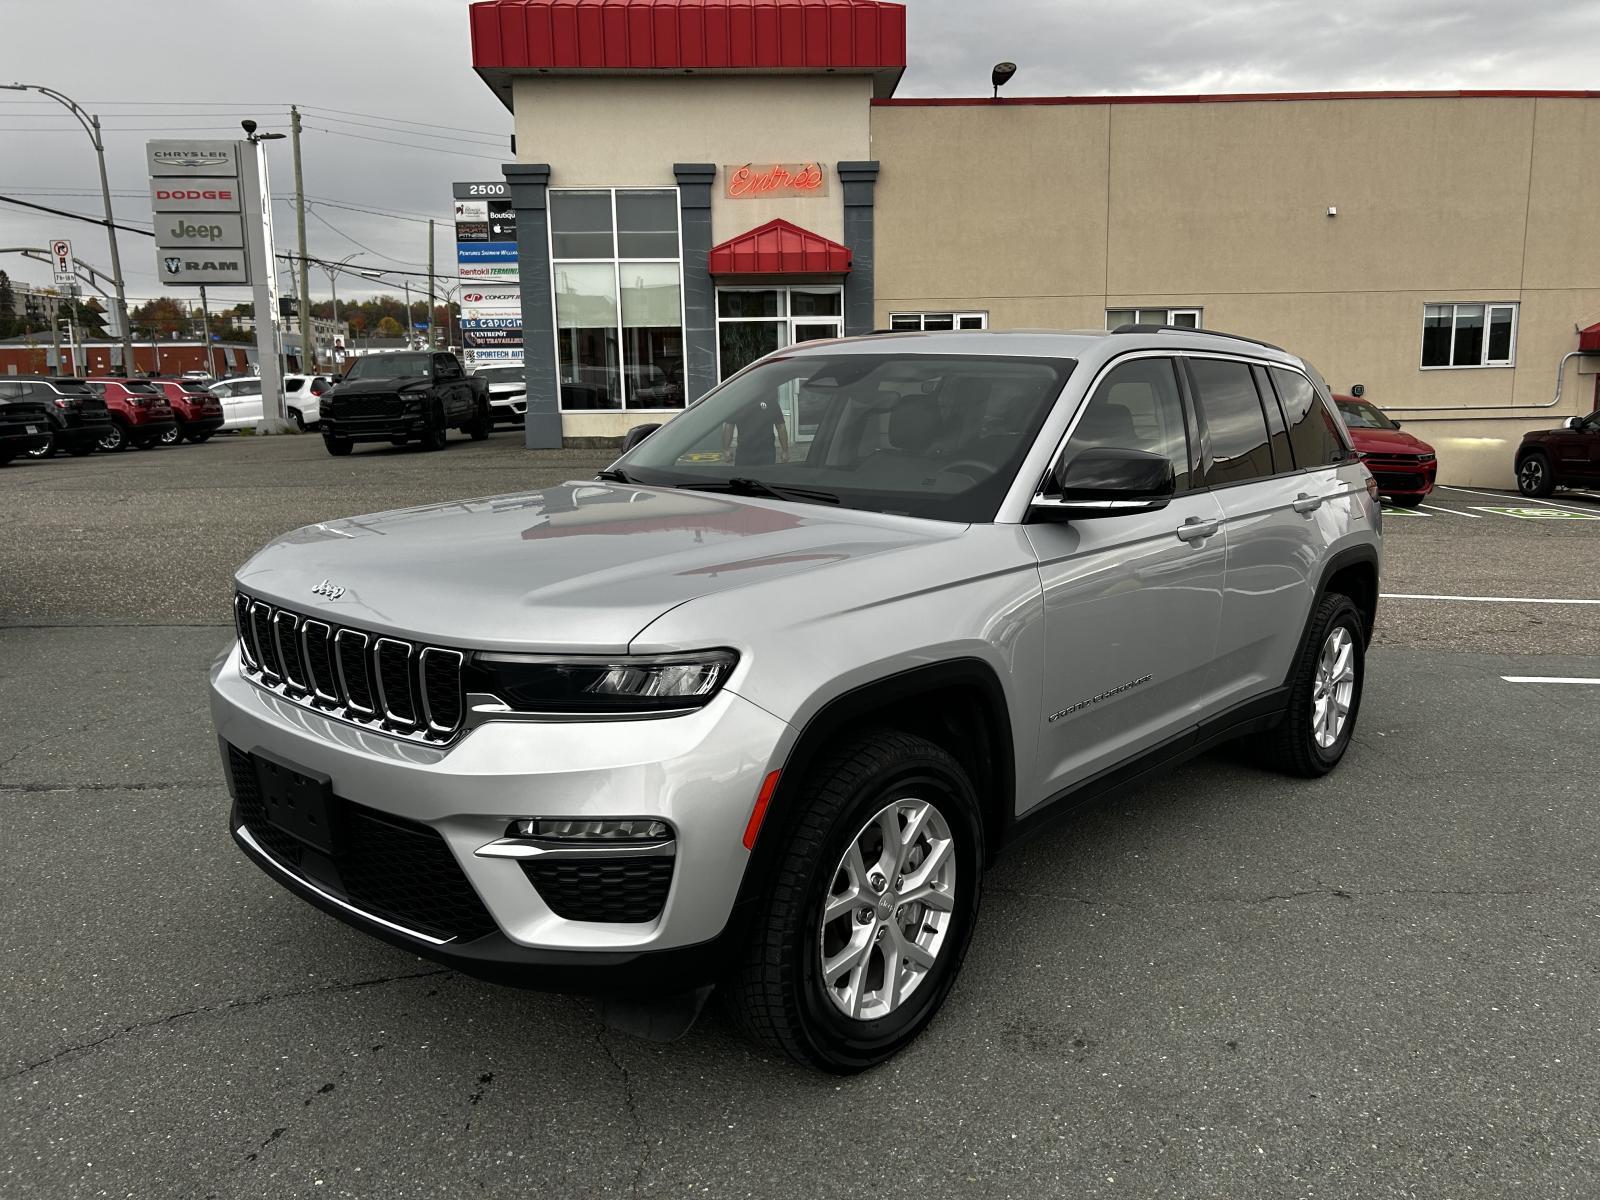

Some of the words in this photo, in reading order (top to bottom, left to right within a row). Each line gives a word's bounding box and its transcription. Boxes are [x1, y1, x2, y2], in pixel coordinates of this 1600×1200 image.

[730, 164, 822, 196] Entrée
[156, 190, 232, 200] DODGE
[469, 184, 505, 195] 2500
[171, 220, 223, 241] Jeep
[185, 261, 239, 271] RAM
[476, 350, 509, 358] SPORTECH
[311, 579, 346, 602] Jeep
